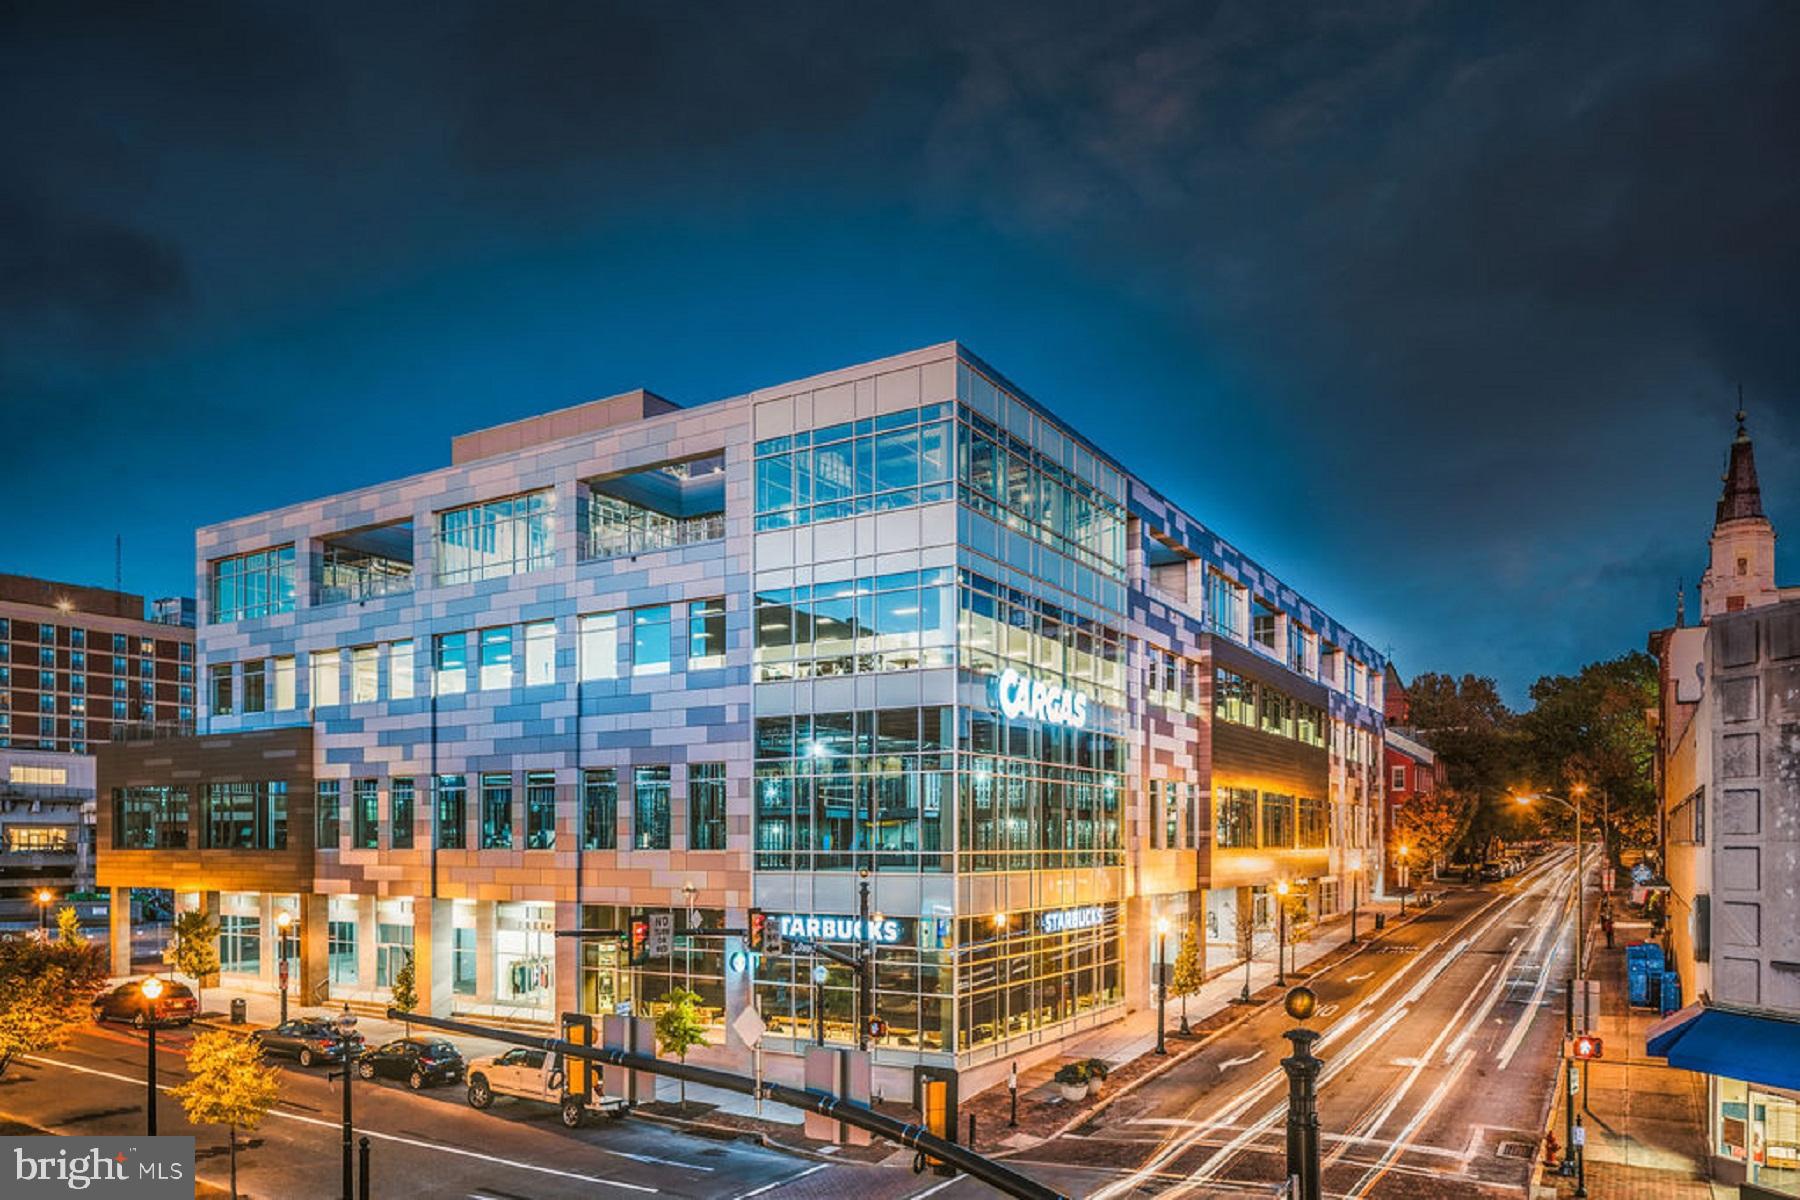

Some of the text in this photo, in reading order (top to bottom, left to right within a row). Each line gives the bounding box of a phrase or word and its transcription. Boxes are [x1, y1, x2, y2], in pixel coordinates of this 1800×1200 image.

[1000, 668, 1087, 728] CARGAS
[655, 916, 669, 927] NO
[767, 916, 897, 941] TARBUCKS
[1045, 907, 1104, 933] STARBUCKS
